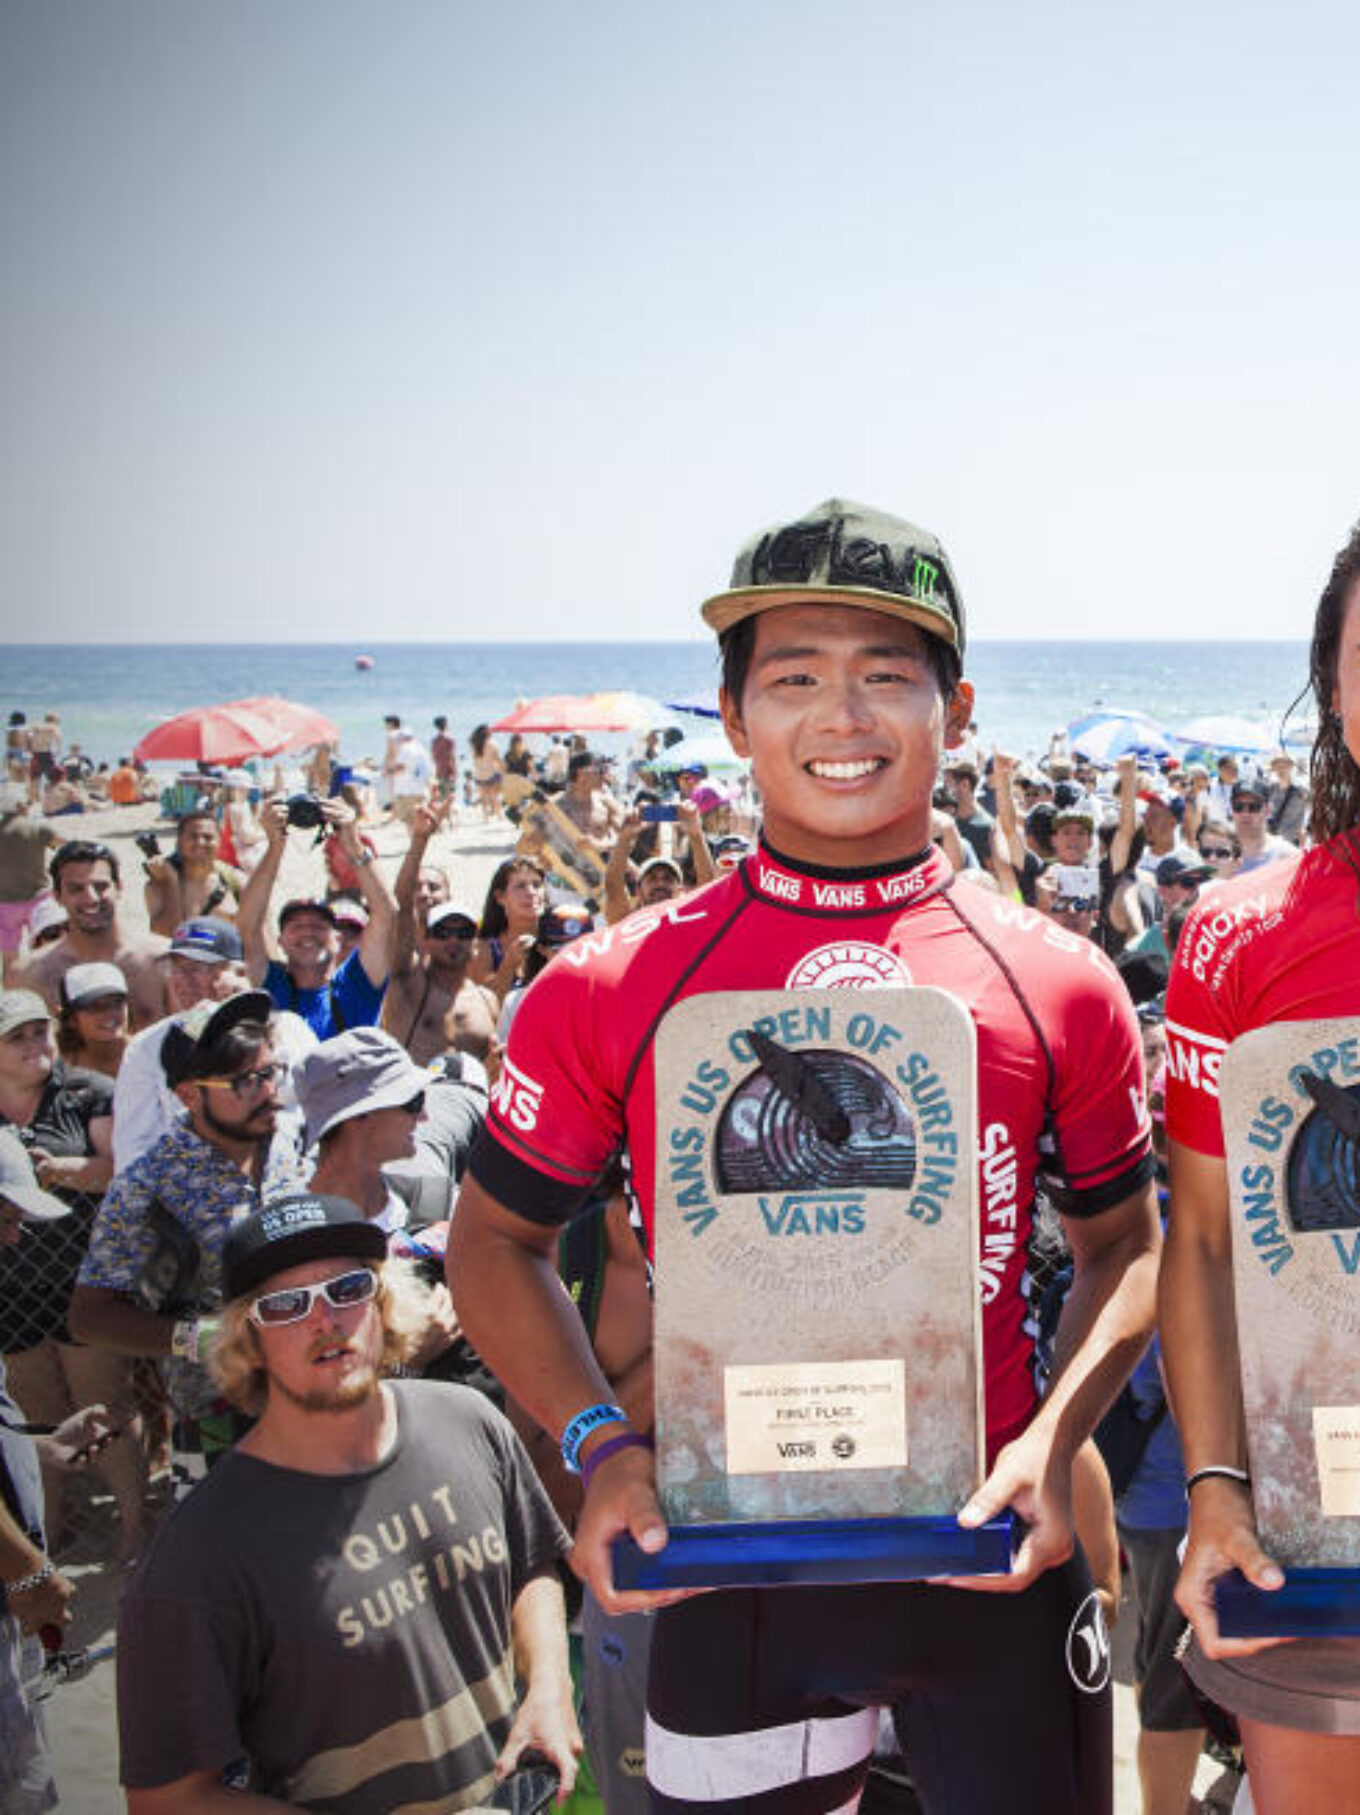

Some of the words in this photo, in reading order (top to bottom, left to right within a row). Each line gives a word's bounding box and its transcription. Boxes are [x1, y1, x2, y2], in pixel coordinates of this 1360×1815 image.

[759, 865, 802, 902] VANS
[812, 882, 866, 908] VANS
[876, 866, 926, 902] VANS
[562, 905, 710, 967] WSL
[727, 1006, 832, 1065] OPEN
[846, 1012, 903, 1055] OF
[680, 1059, 730, 1115] US
[896, 1051, 960, 1226] SURFING
[1248, 1096, 1294, 1152] US
[668, 1126, 720, 1237] VANS
[757, 1193, 868, 1238] VANS
[978, 1122, 1018, 1305] SURFING
[1242, 1164, 1294, 1276] VANS
[776, 1406, 811, 1420] FIRST
[816, 1405, 855, 1419] PLACE
[776, 1440, 817, 1459] VANS
[343, 1484, 457, 1572] QUIT
[337, 1525, 506, 1647] SURFING
